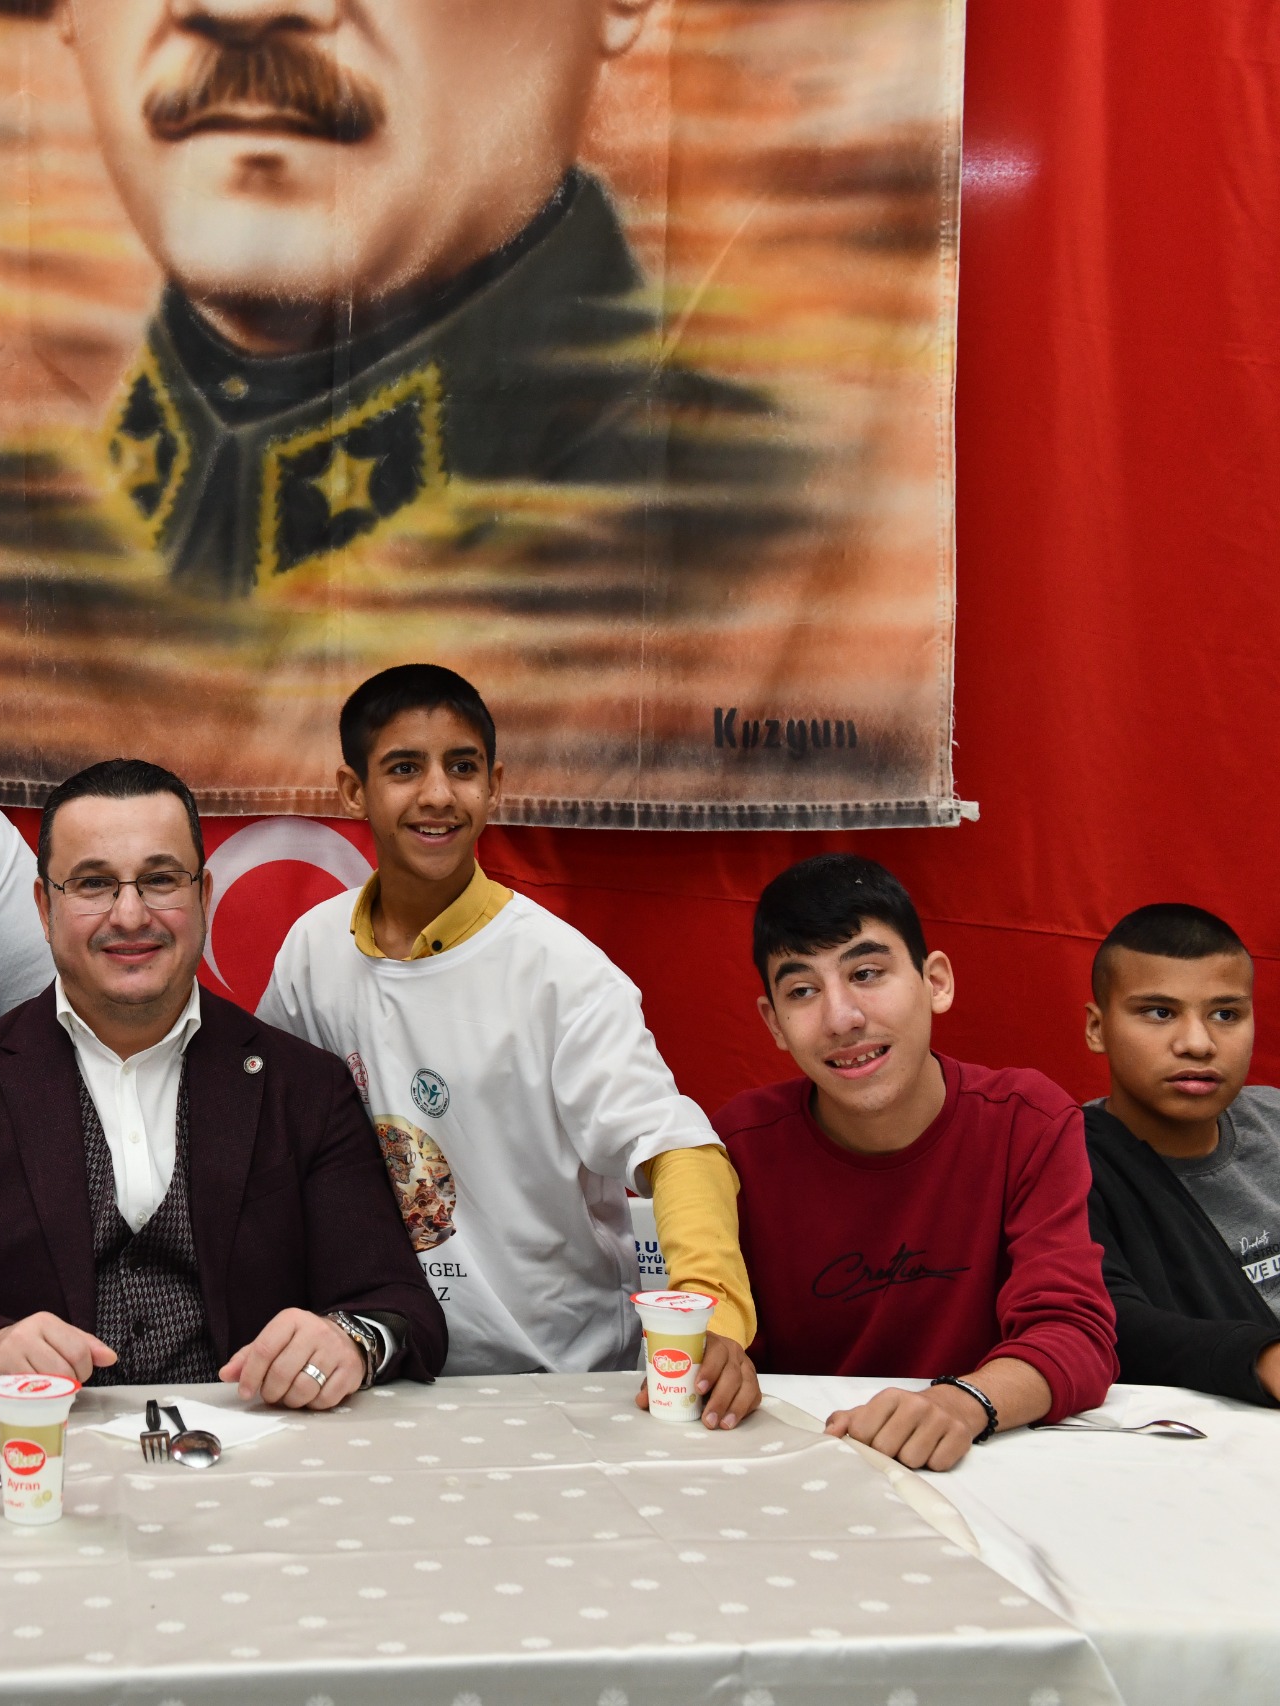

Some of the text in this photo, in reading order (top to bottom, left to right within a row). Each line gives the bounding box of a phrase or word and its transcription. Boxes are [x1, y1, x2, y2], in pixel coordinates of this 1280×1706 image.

[423, 1262, 467, 1278] GEL
[656, 1382, 687, 1395] Ayran
[7, 1478, 41, 1492] Ayran
